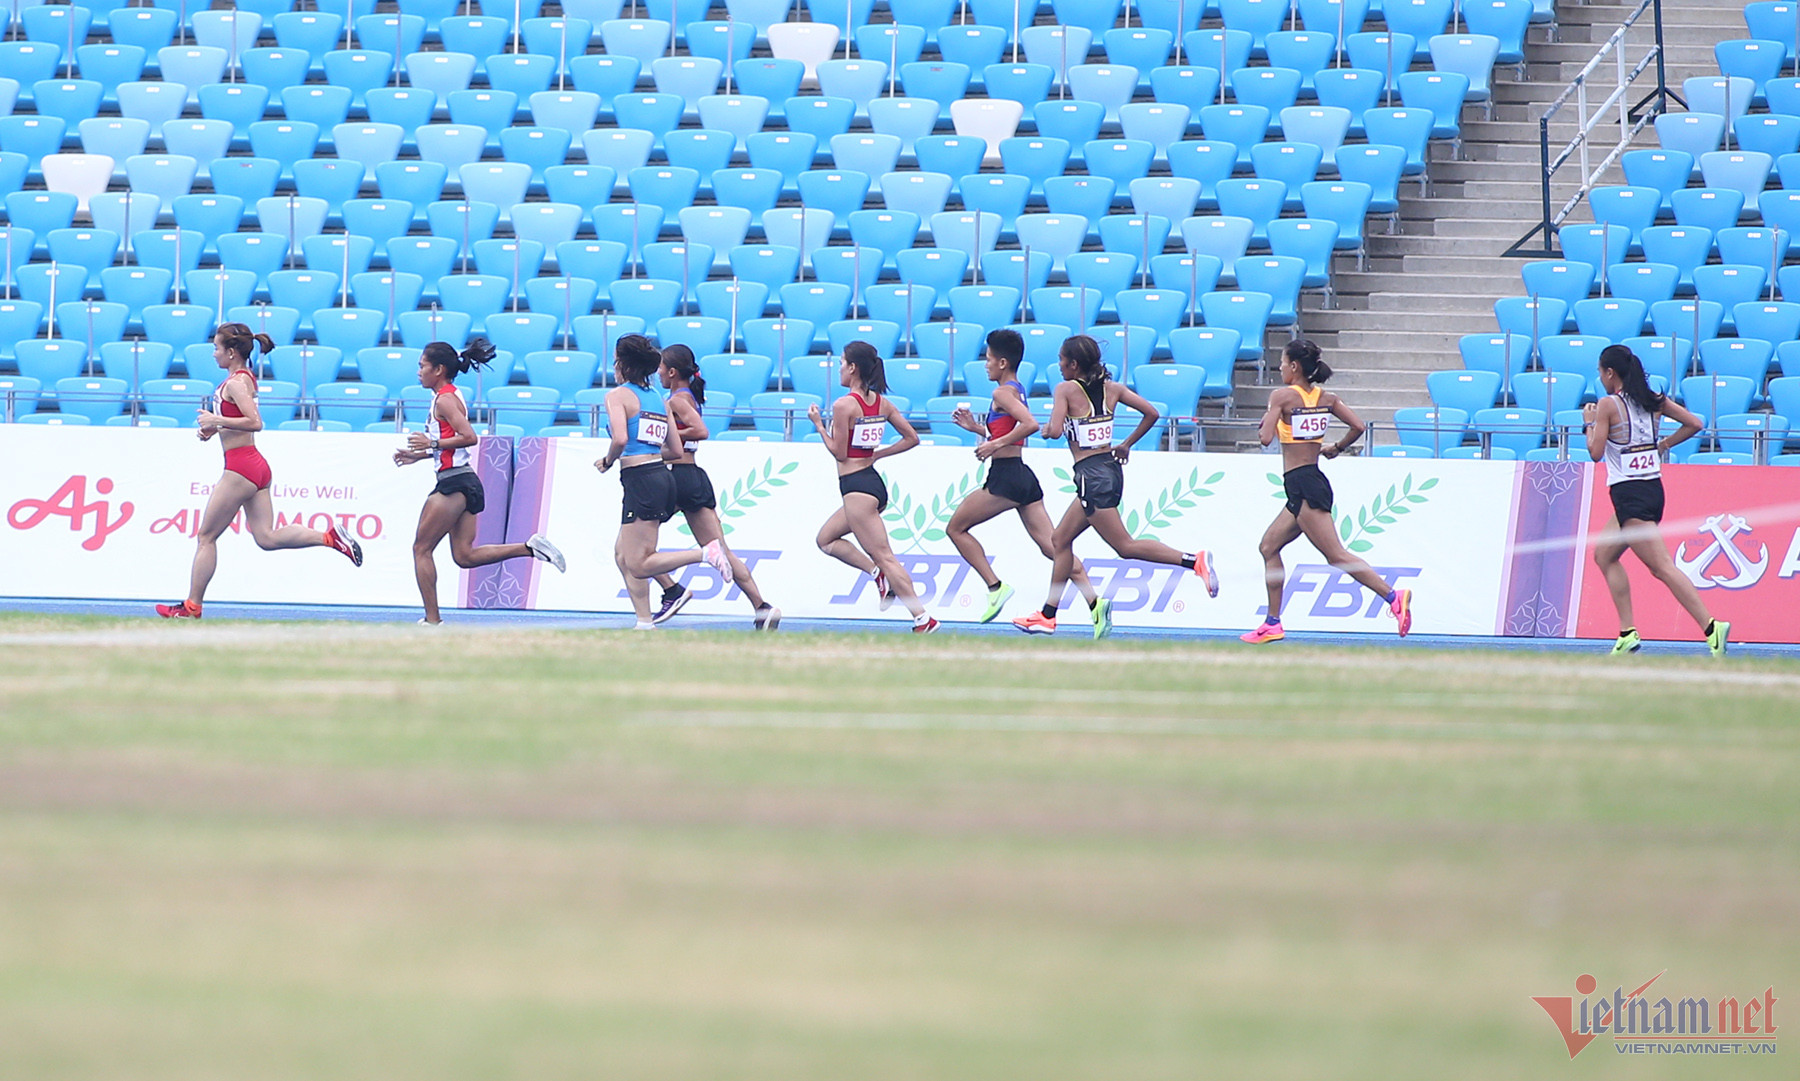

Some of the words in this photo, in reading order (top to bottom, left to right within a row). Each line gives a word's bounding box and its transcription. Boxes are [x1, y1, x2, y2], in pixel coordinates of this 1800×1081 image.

[645, 423, 666, 439] 403
[1300, 417, 1328, 432] 456
[861, 427, 883, 442] 559
[1088, 426, 1112, 441] 539
[1629, 454, 1655, 470] 424
[273, 484, 309, 498] Live
[315, 485, 358, 500] Well.
[7, 475, 134, 551] Aj
[1255, 563, 1423, 618] FBT
